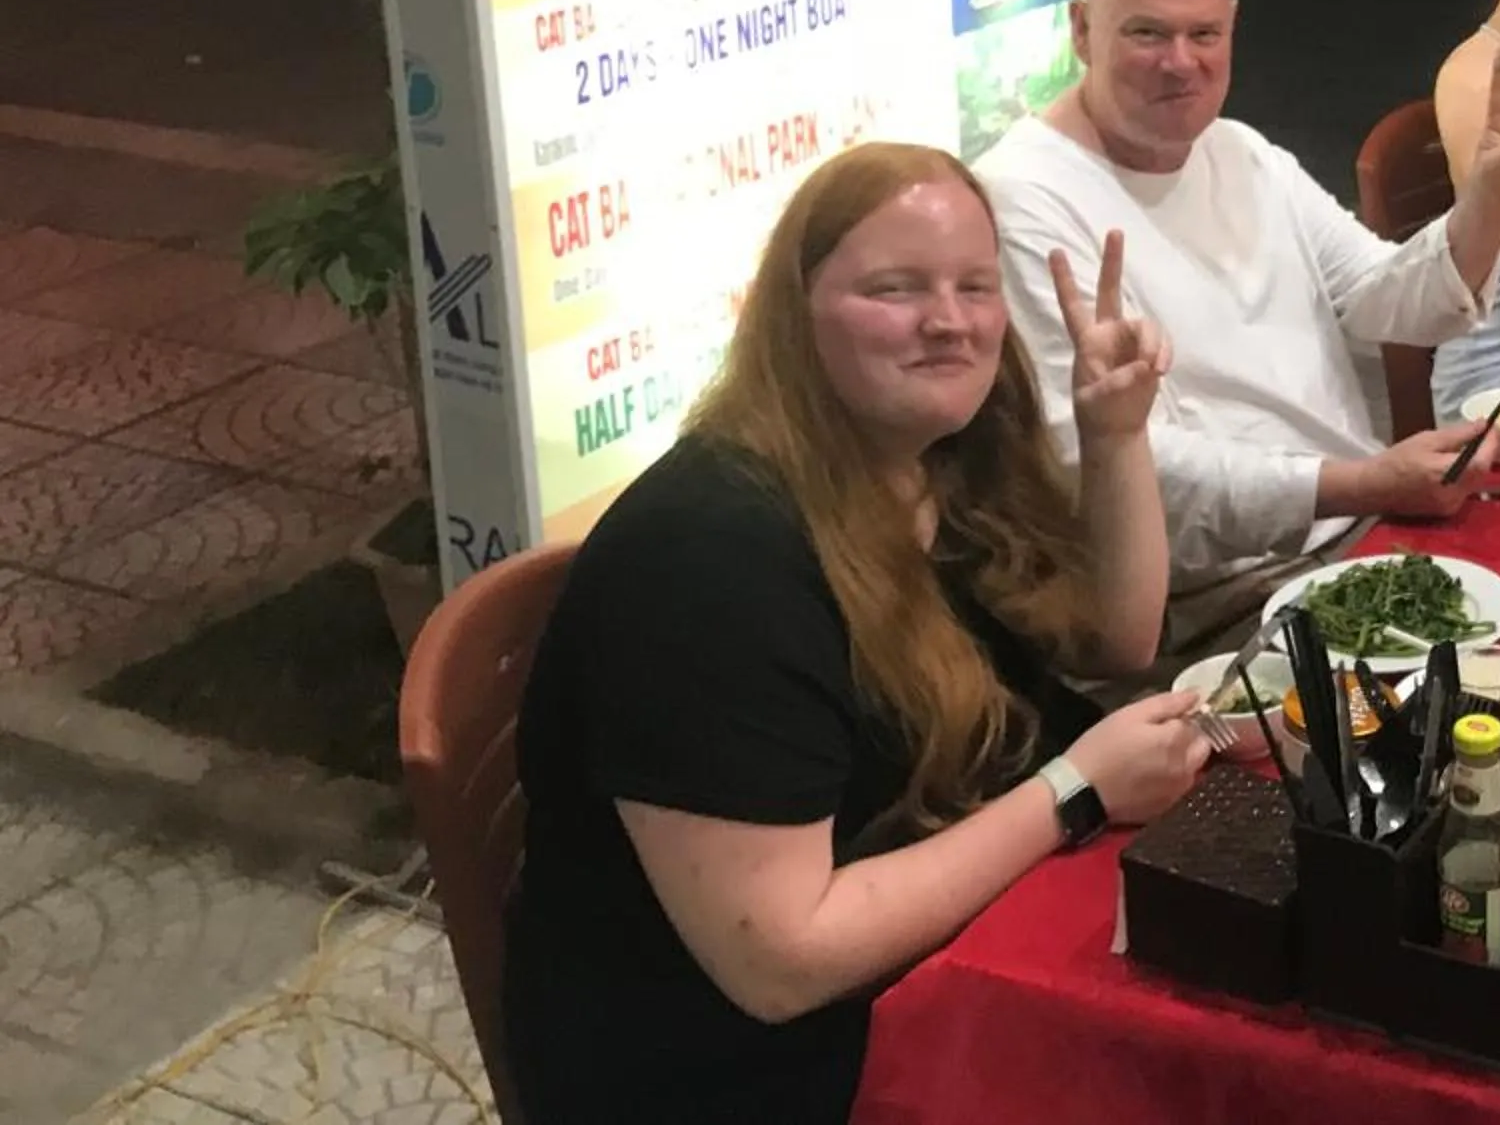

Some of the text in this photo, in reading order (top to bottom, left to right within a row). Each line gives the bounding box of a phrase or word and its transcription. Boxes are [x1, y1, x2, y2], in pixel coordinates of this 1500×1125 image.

[534, 8, 568, 53] CAT
[575, 59, 592, 107] 2
[684, 17, 730, 72] ONE
[766, 110, 822, 175] PARK
[547, 179, 632, 259] CAT BA
[585, 335, 622, 382] CAT
[574, 384, 636, 459] HALF
